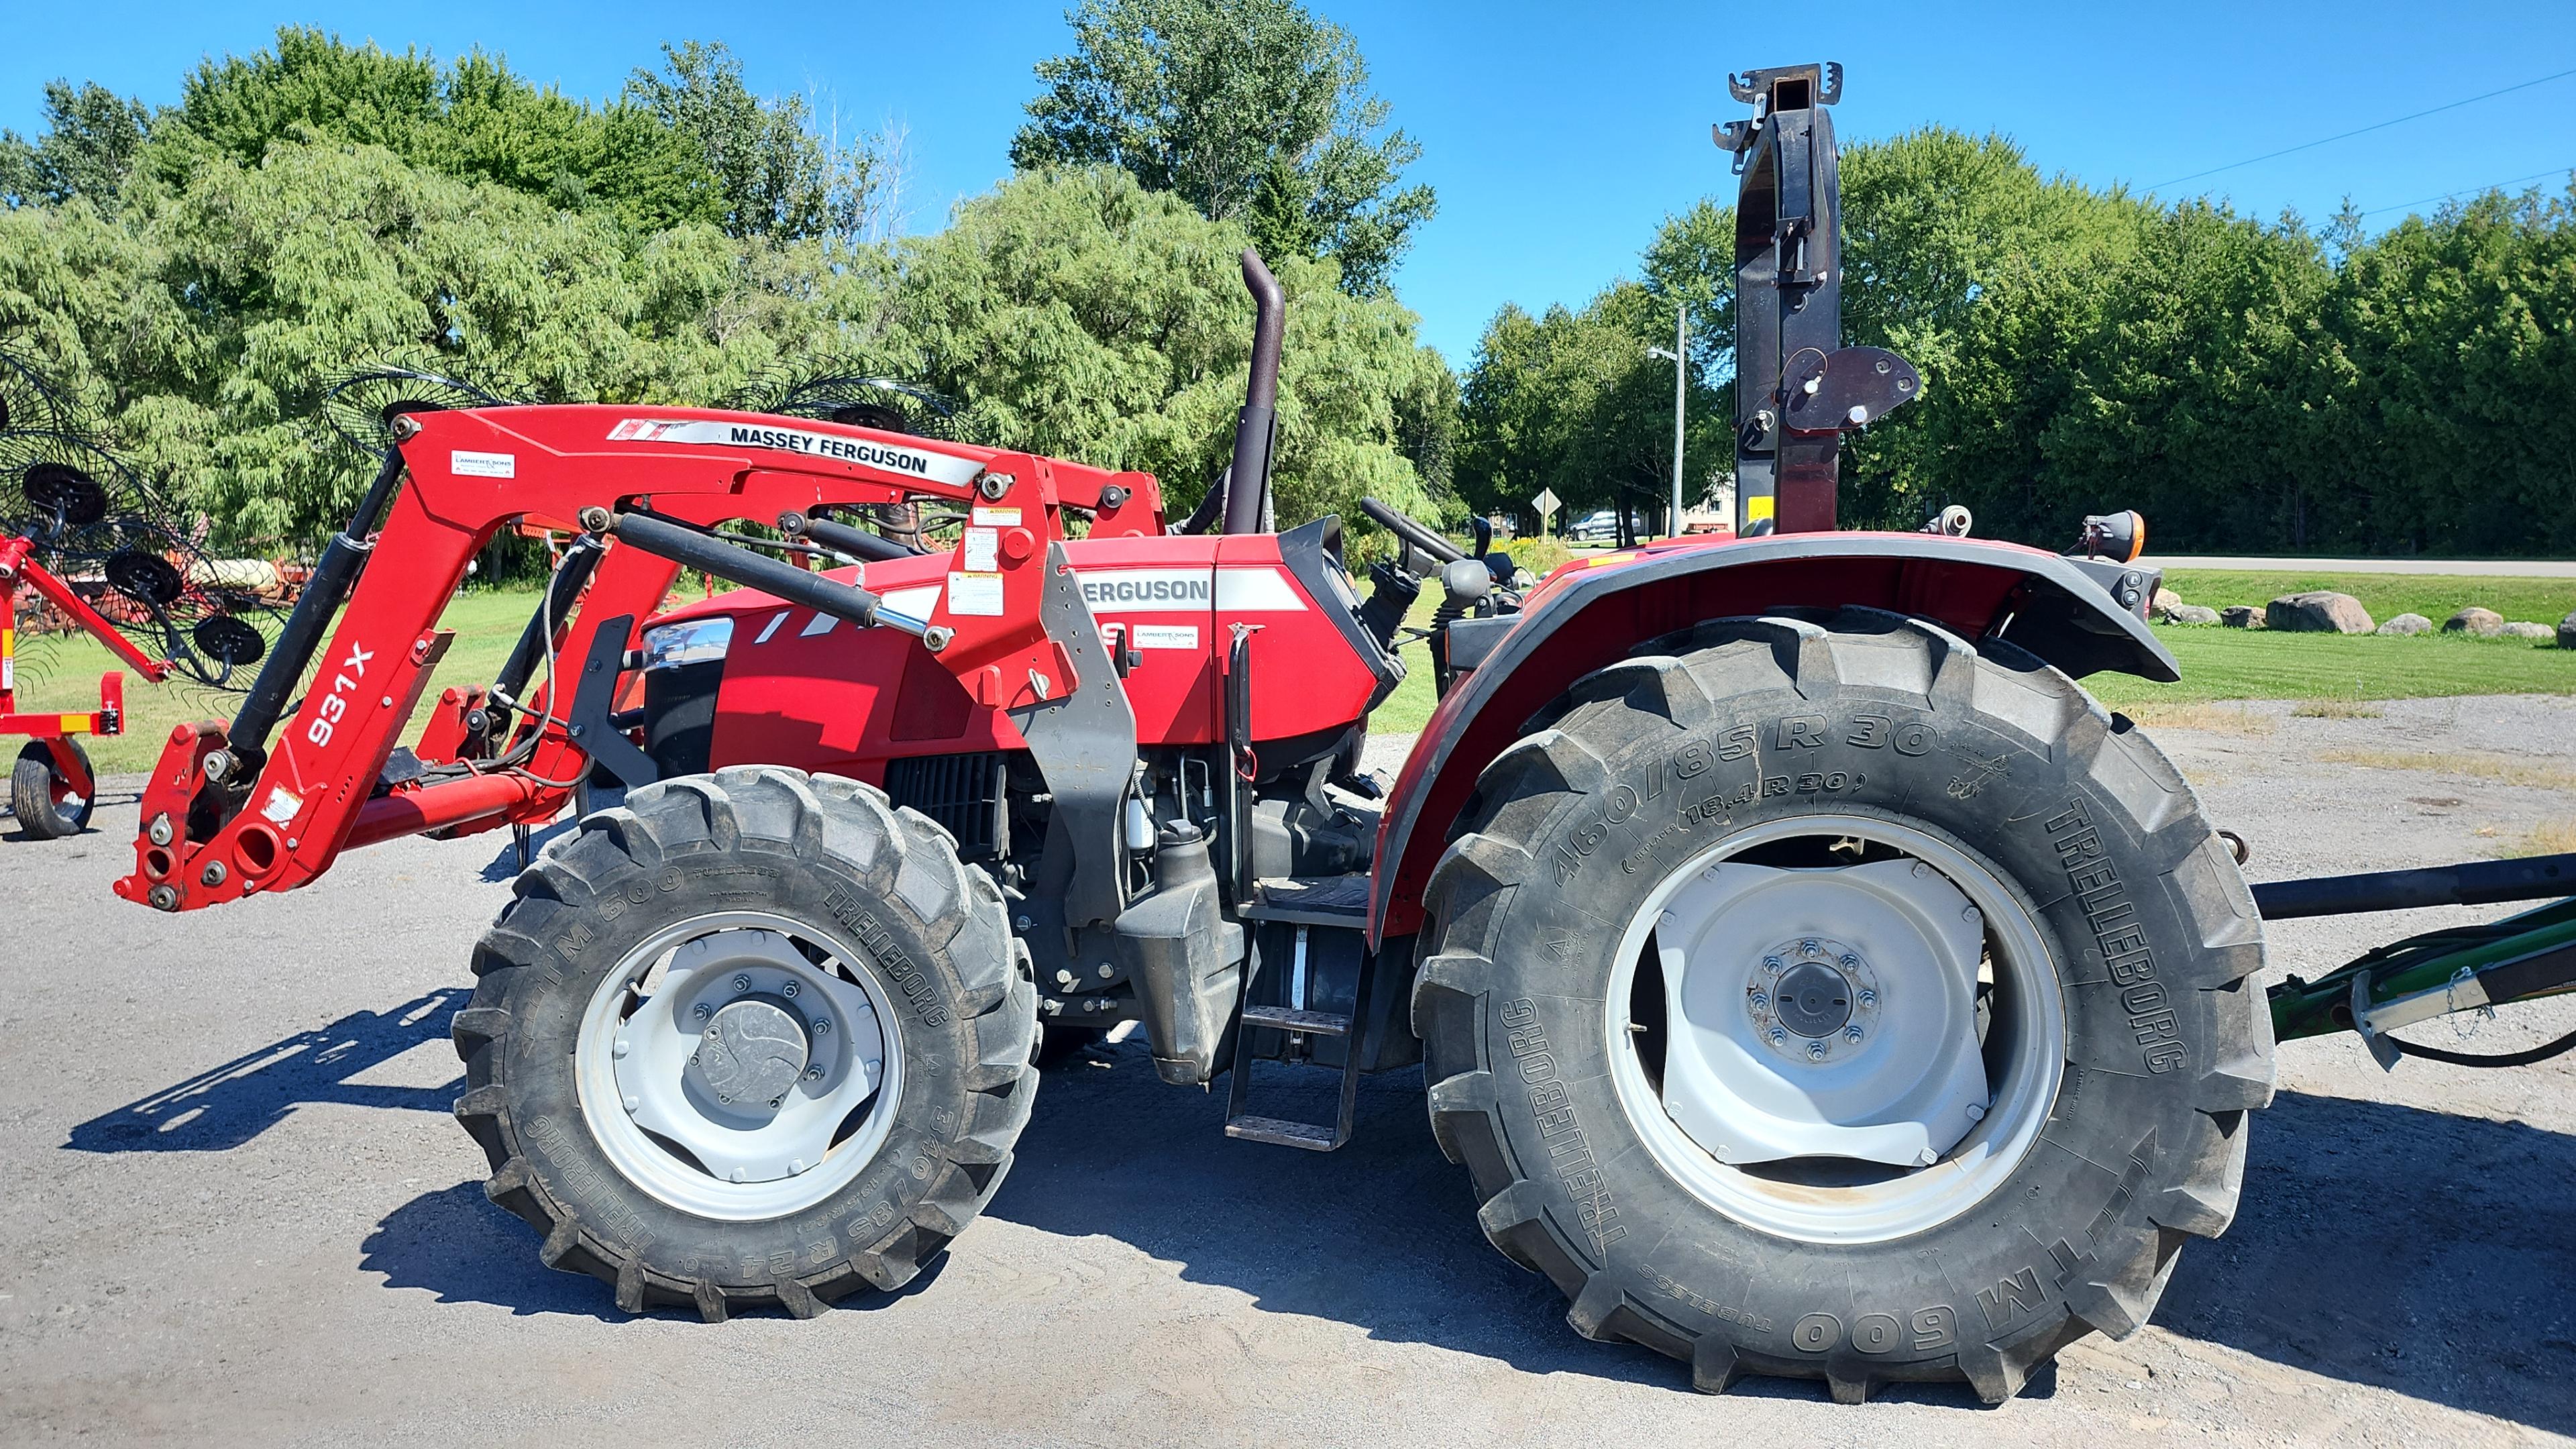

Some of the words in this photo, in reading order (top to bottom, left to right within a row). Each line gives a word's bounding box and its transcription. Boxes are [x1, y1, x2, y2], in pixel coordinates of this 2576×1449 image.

[731, 427, 814, 453] MASSEY
[820, 439, 927, 474] FERGUSON
[1083, 580, 1210, 602] ERGUSON
[307, 640, 374, 747] 931X
[1550, 722, 1757, 888] 460/85
[1775, 714, 1828, 751] R
[1845, 714, 1938, 757] 30
[1686, 782, 1756, 826] 18.4
[1762, 774, 1790, 798] R
[598, 866, 684, 922] 600
[824, 881, 951, 1028] TRELLEBORG
[2044, 797, 2190, 1075] TRELLEBORG
[1498, 996, 1629, 1258] TRELLEBORG
[524, 1115, 656, 1258] TRELLEBORG
[740, 1251, 795, 1279] 24
[807, 1237, 839, 1265] R
[1635, 1263, 1772, 1334] TUBELESS
[1790, 1303, 1960, 1354] 600
